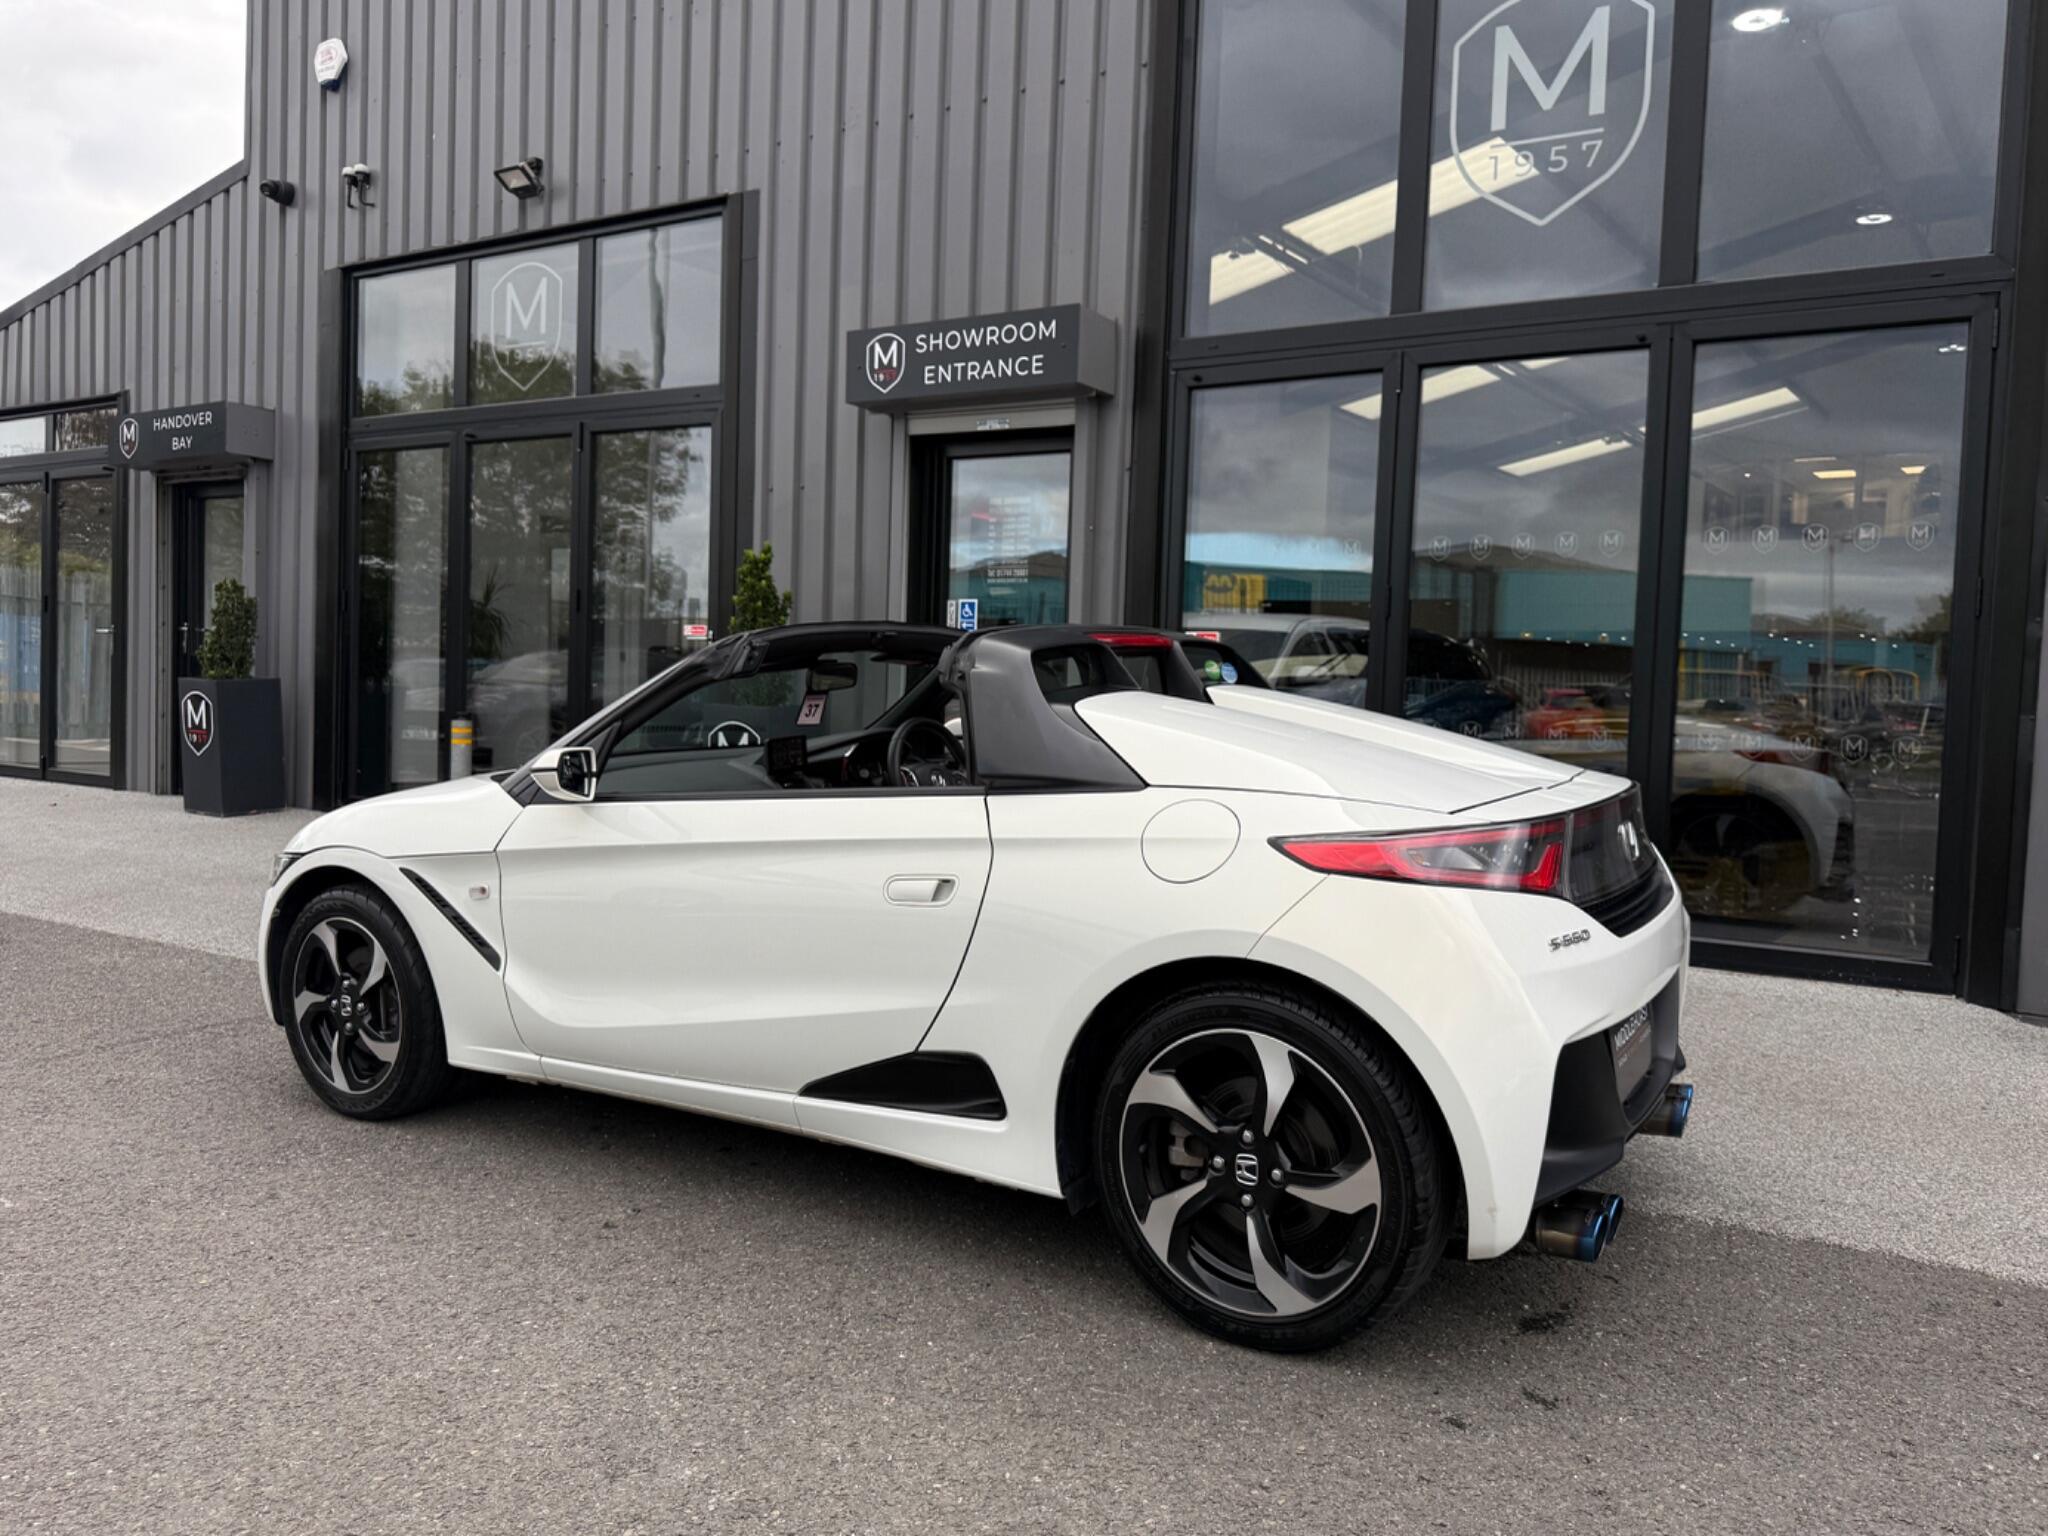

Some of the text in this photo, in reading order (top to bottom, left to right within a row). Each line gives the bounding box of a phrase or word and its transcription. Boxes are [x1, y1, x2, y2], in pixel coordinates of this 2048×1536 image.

[1490, 5, 1611, 132] M
[1488, 139, 1603, 181] 1957
[506, 276, 547, 339] M
[915, 318, 1057, 354] SHOWROOM
[873, 339, 898, 370] M
[924, 354, 1044, 385] ENTRANCE
[122, 423, 136, 443] M
[153, 411, 213, 431] HANDOVER
[172, 436, 193, 451] BAY
[187, 698, 207, 729] M
[804, 703, 820, 718] 37
